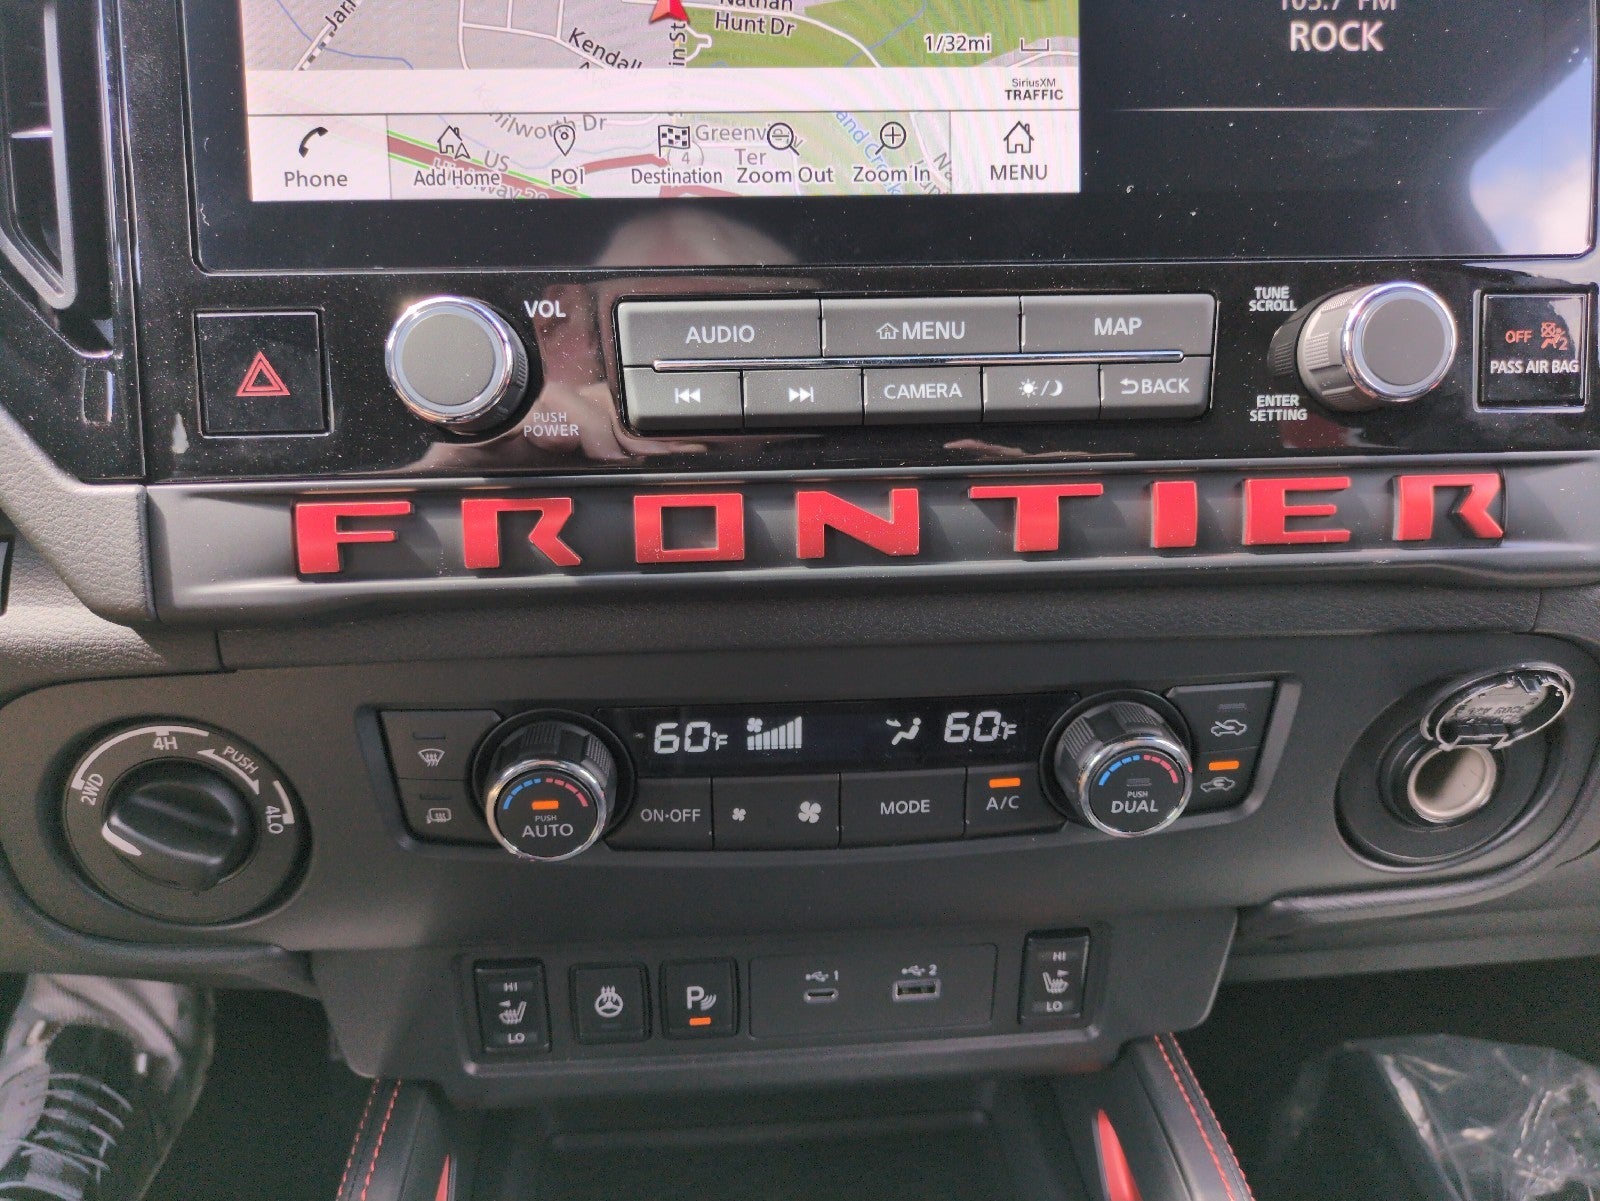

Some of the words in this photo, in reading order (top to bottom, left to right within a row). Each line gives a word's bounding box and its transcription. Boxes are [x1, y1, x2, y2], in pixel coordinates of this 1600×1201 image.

[669, 22, 686, 42] St
[715, 12, 765, 34] Hunt
[771, 17, 795, 37] Dr
[924, 34, 992, 53] 1/32mi
[1290, 20, 1384, 52] ROCK
[1011, 78, 1057, 88] SiriusXM
[1005, 88, 1064, 101] TRAFFIC
[582, 114, 608, 132] Dr
[484, 150, 511, 172] US
[734, 148, 767, 166] Ter
[284, 171, 348, 188] Phone
[413, 169, 446, 186] Add
[452, 169, 501, 186] Home
[551, 168, 585, 185] POI
[631, 167, 723, 184] Destination
[736, 167, 792, 184] Zoom
[798, 166, 834, 183] Out
[852, 166, 908, 182] Zoom
[914, 165, 931, 182] In
[989, 164, 1048, 181] MENU
[1254, 286, 1290, 300] TUNE
[523, 300, 567, 318] VOL
[1249, 299, 1297, 312] SCROLL
[685, 325, 755, 344] AUDIO
[901, 321, 967, 341] MENU
[1093, 317, 1143, 336] MAP
[1505, 329, 1533, 344] OFF
[1490, 360, 1523, 374] PASS
[1525, 360, 1549, 374] AIR
[1551, 359, 1580, 374] BAG
[883, 382, 963, 400] CAMERA
[1141, 378, 1191, 395] BACK
[1256, 394, 1300, 408] ENTER
[532, 411, 567, 423] PUSH
[1249, 408, 1308, 422] SETTING
[523, 424, 580, 437] POWER
[294, 473, 1503, 574] FRONTIER
[152, 736, 178, 751] 4H
[222, 745, 259, 774] PUSH
[81, 773, 105, 806] 2WD
[1127, 790, 1149, 798] PUSH
[880, 799, 931, 816] MODE
[985, 796, 1020, 811] A/C
[1110, 799, 1159, 814] DUAL
[265, 805, 284, 835] 4LO
[534, 814, 558, 822] PUSH
[521, 823, 574, 838] AUTO
[1053, 951, 1067, 962] HI
[928, 964, 937, 976] 2
[503, 982, 518, 992] HI
[1046, 1001, 1063, 1012] LO
[507, 1032, 525, 1044] LO
